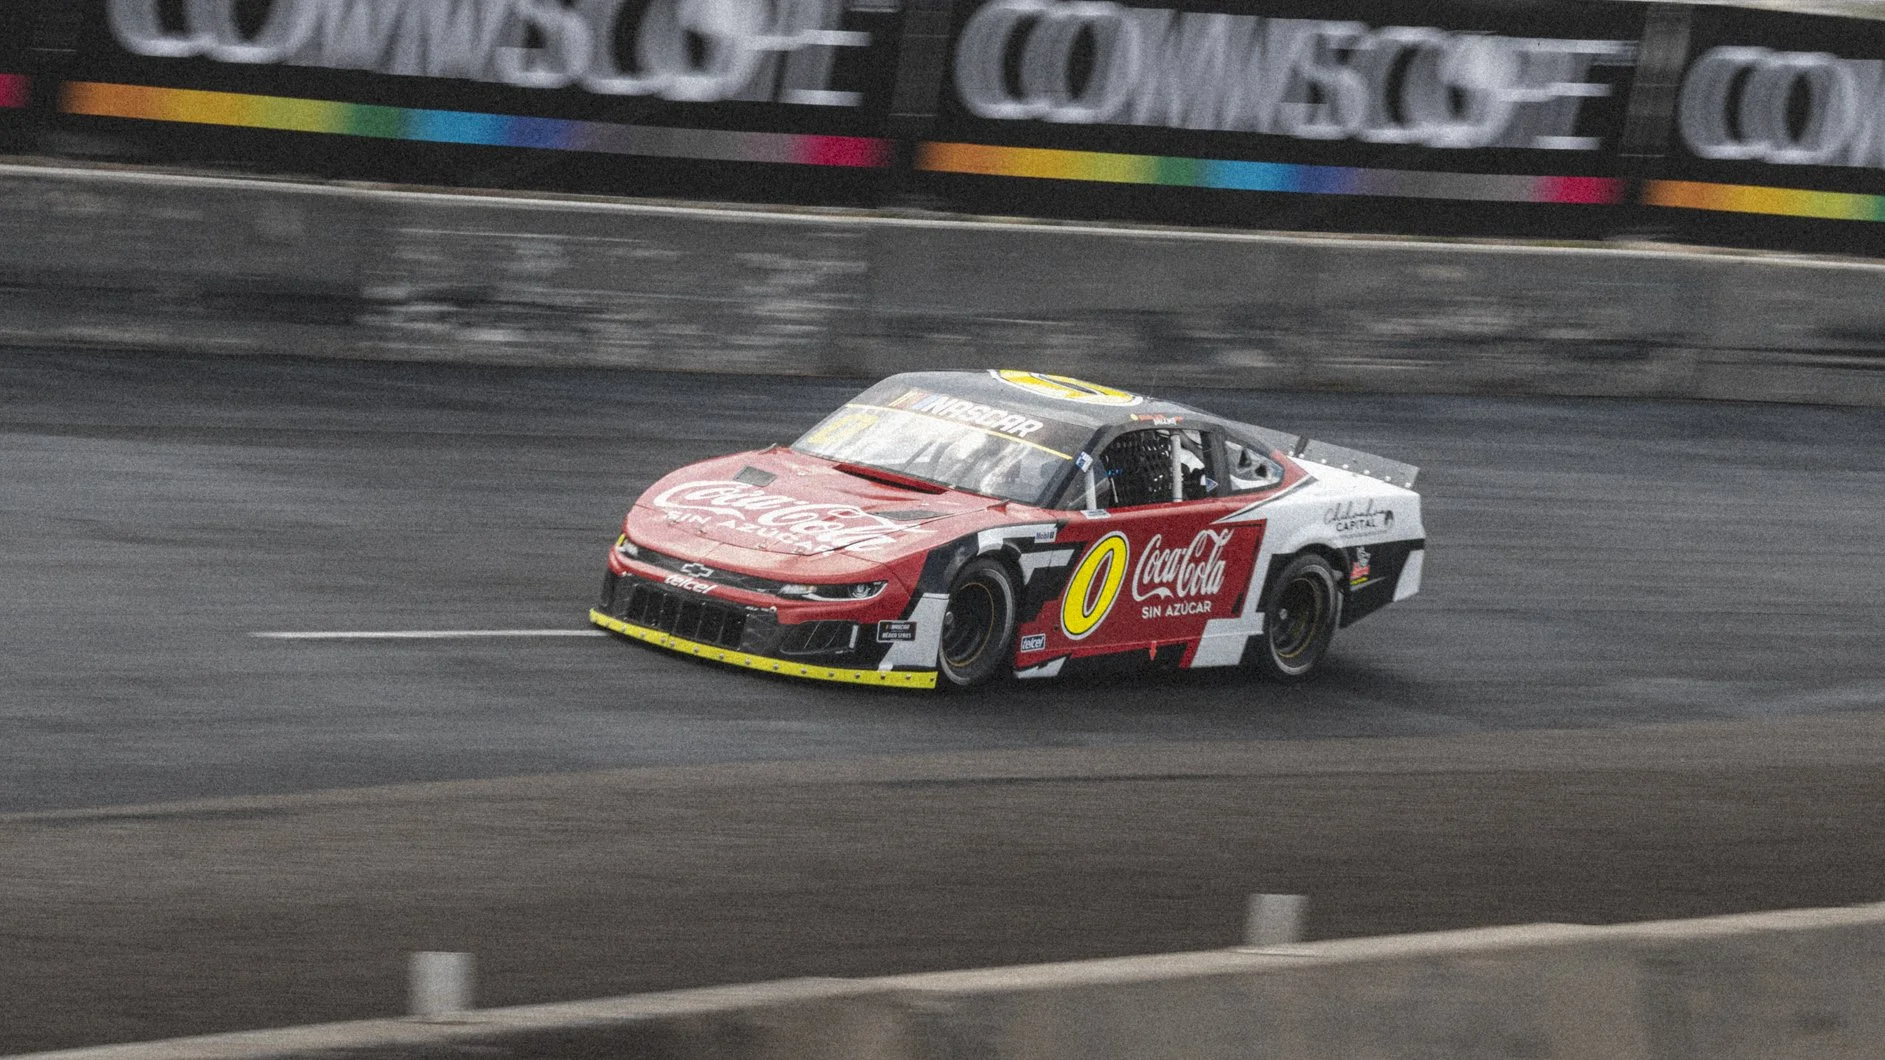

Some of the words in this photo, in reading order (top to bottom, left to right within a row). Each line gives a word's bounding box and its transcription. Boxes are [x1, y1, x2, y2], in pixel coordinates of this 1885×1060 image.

[953, 0, 1622, 149] COMMSCOPE
[921, 394, 1043, 438] NASCAR
[1336, 519, 1377, 532] CAPITAL
[664, 574, 718, 594] telcel
[1061, 531, 1130, 640] 0
[1132, 529, 1235, 602] Coca-Cola
[1142, 605, 1162, 619] SIN
[1165, 600, 1213, 617] AZÚCAR
